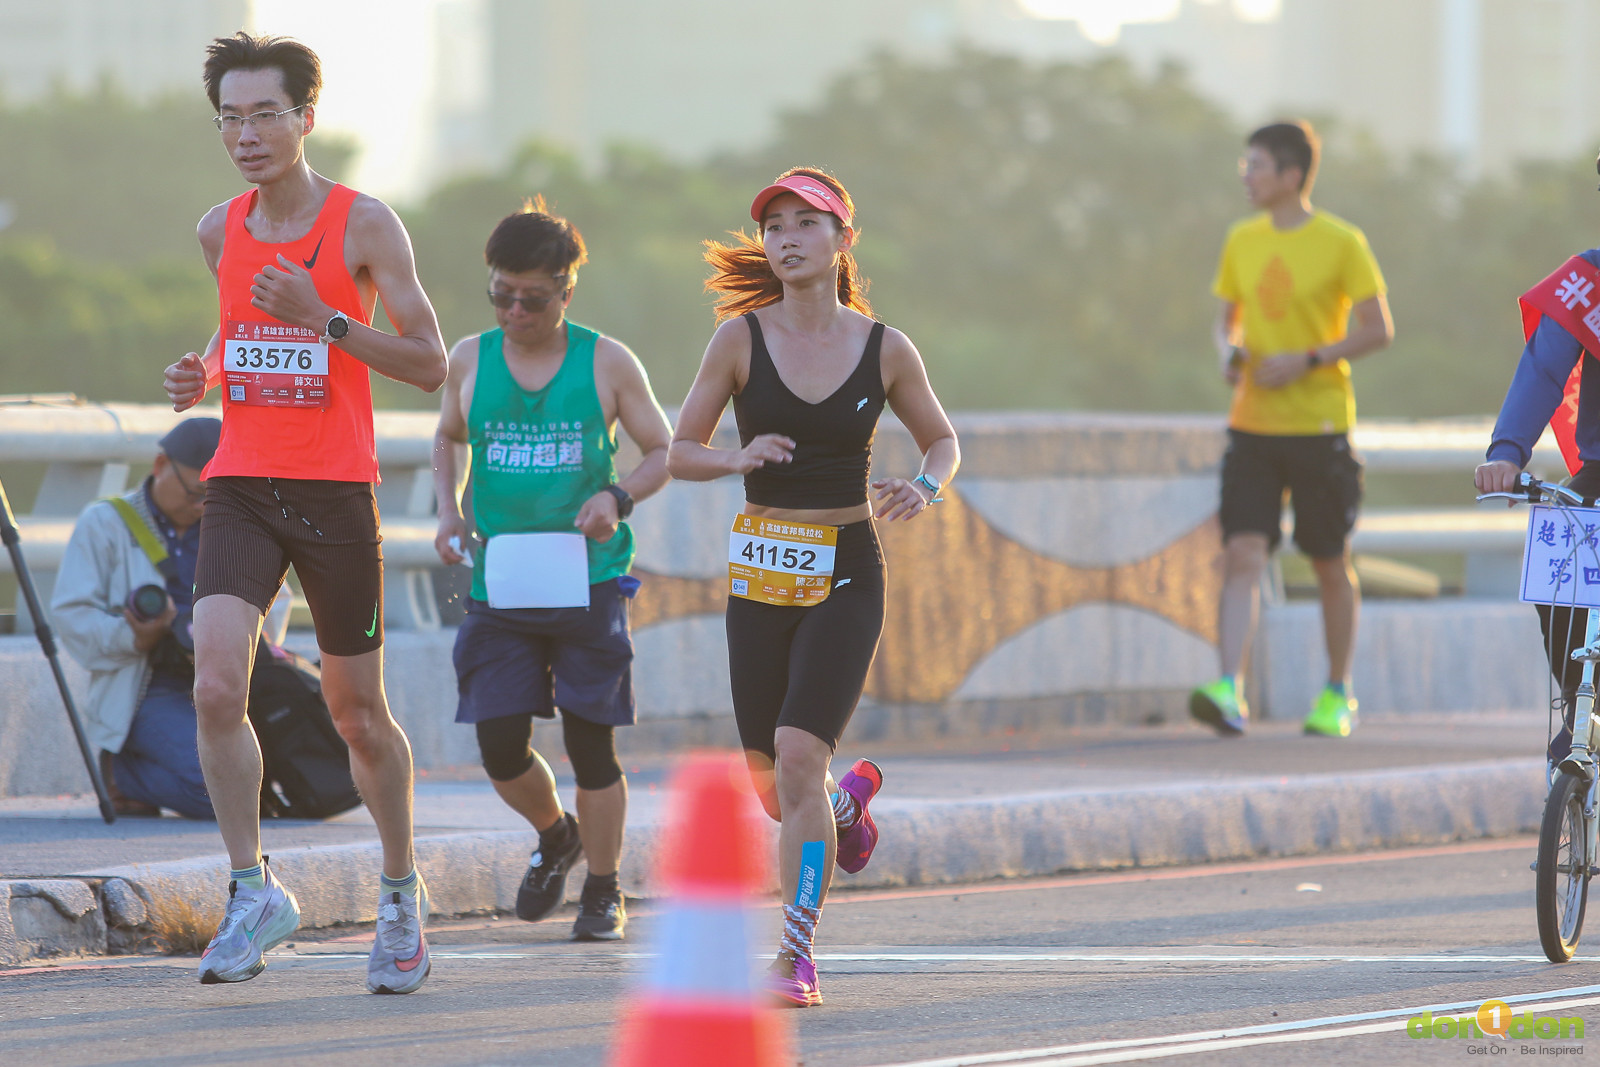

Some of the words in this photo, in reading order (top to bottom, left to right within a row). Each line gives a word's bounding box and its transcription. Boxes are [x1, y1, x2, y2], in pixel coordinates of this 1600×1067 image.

[235, 346, 313, 370] 33576
[294, 376, 324, 387] 薛文山
[484, 421, 583, 433] KAOHSIUNG
[485, 432, 522, 441] FUBON
[524, 432, 583, 442] MARATHON
[486, 441, 583, 467] 向前超越
[766, 523, 824, 539] 高雄富邦馬拉松
[741, 541, 817, 571] 41152
[795, 576, 826, 587] 陳乙萱
